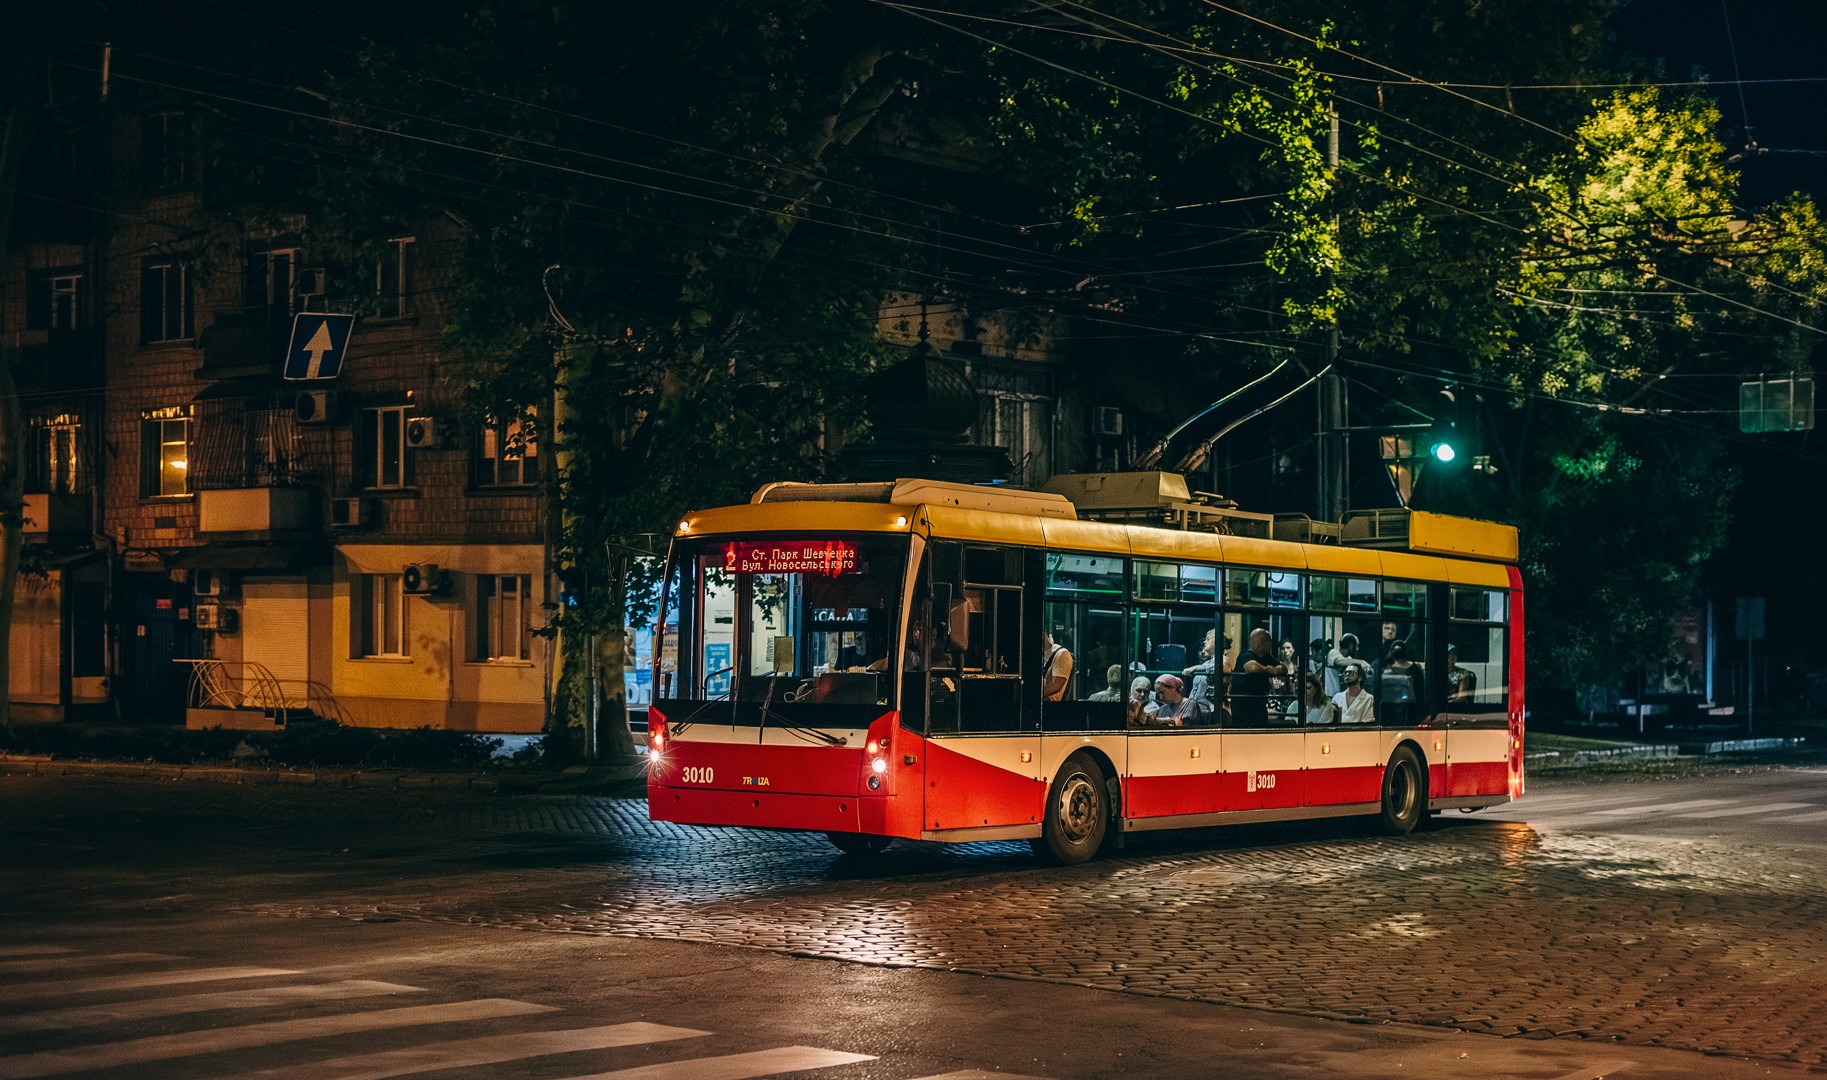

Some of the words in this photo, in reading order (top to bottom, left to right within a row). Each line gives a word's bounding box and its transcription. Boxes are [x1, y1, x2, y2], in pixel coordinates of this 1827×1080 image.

[726, 551, 736, 571] 2
[752, 549, 767, 561] Ст.
[772, 549, 798, 561] Парк
[742, 560, 763, 572] Вул.
[682, 766, 714, 784] 3010
[1256, 774, 1276, 789] 3010
